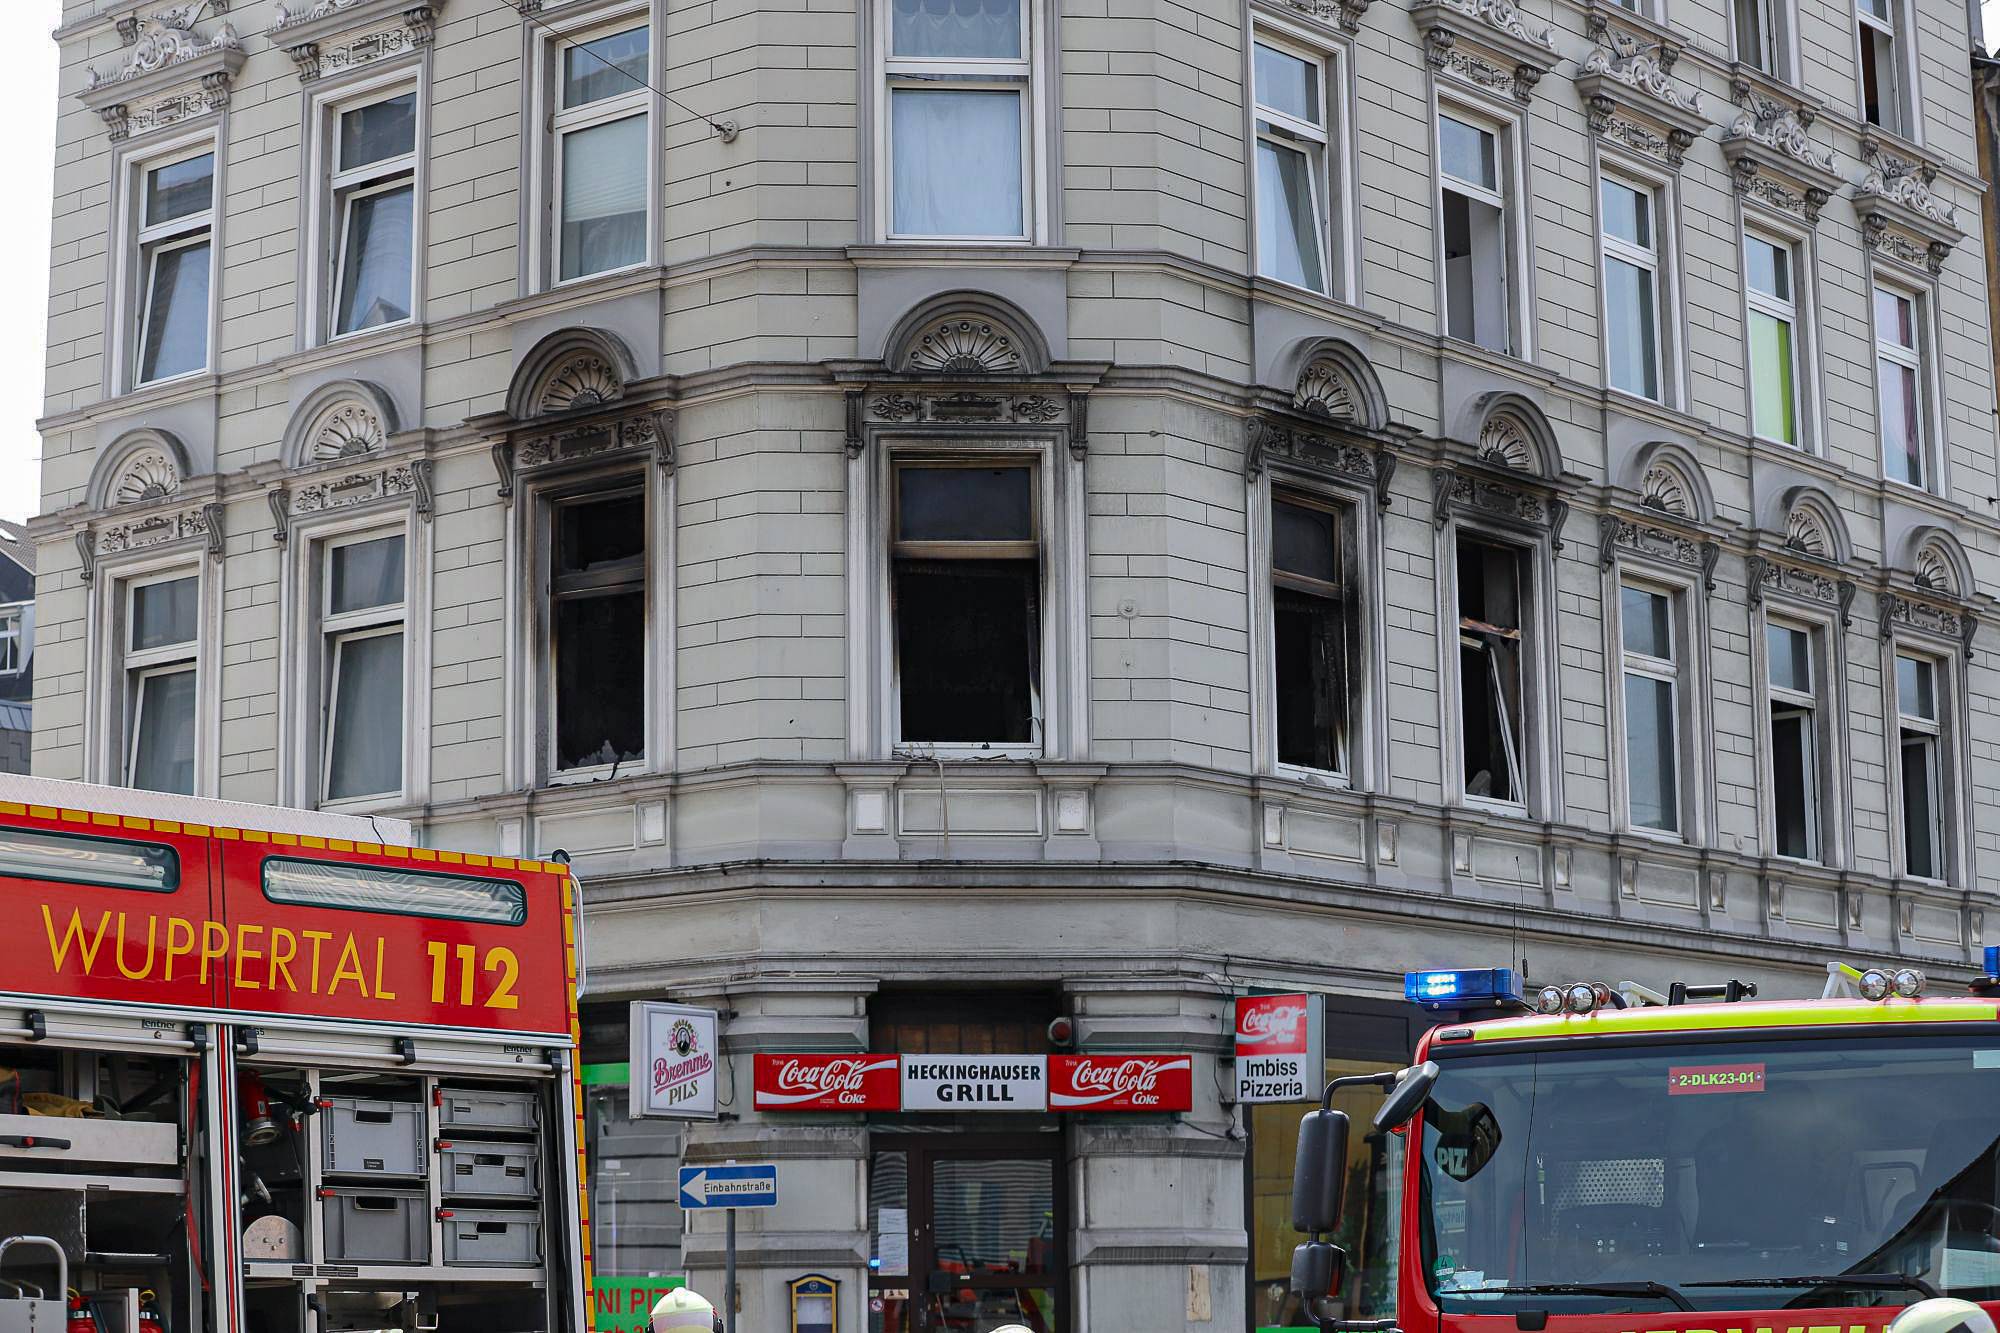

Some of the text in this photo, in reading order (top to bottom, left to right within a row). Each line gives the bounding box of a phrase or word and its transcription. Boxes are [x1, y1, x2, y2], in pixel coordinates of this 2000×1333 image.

[41, 904, 520, 1009] WUPPERTAL 112
[653, 1052, 713, 1089] Bremme
[778, 1059, 867, 1090] Coca-Cola
[908, 1064, 1041, 1080] HECKINGHAUSER
[1071, 1060, 1159, 1092] Coca-Cola
[1246, 1058, 1298, 1077] Imbiss
[1240, 1079, 1303, 1098] Pizzeria
[1679, 1072, 1754, 1086] 2-DLK23-01
[669, 1080, 698, 1105] PILS
[838, 1091, 866, 1104] Coke
[936, 1084, 1014, 1102] GRILL
[1131, 1092, 1159, 1105] Coke
[1437, 1148, 1468, 1176] PIZ
[704, 1182, 771, 1194] Einbahnstraße
[597, 1288, 621, 1314] NI
